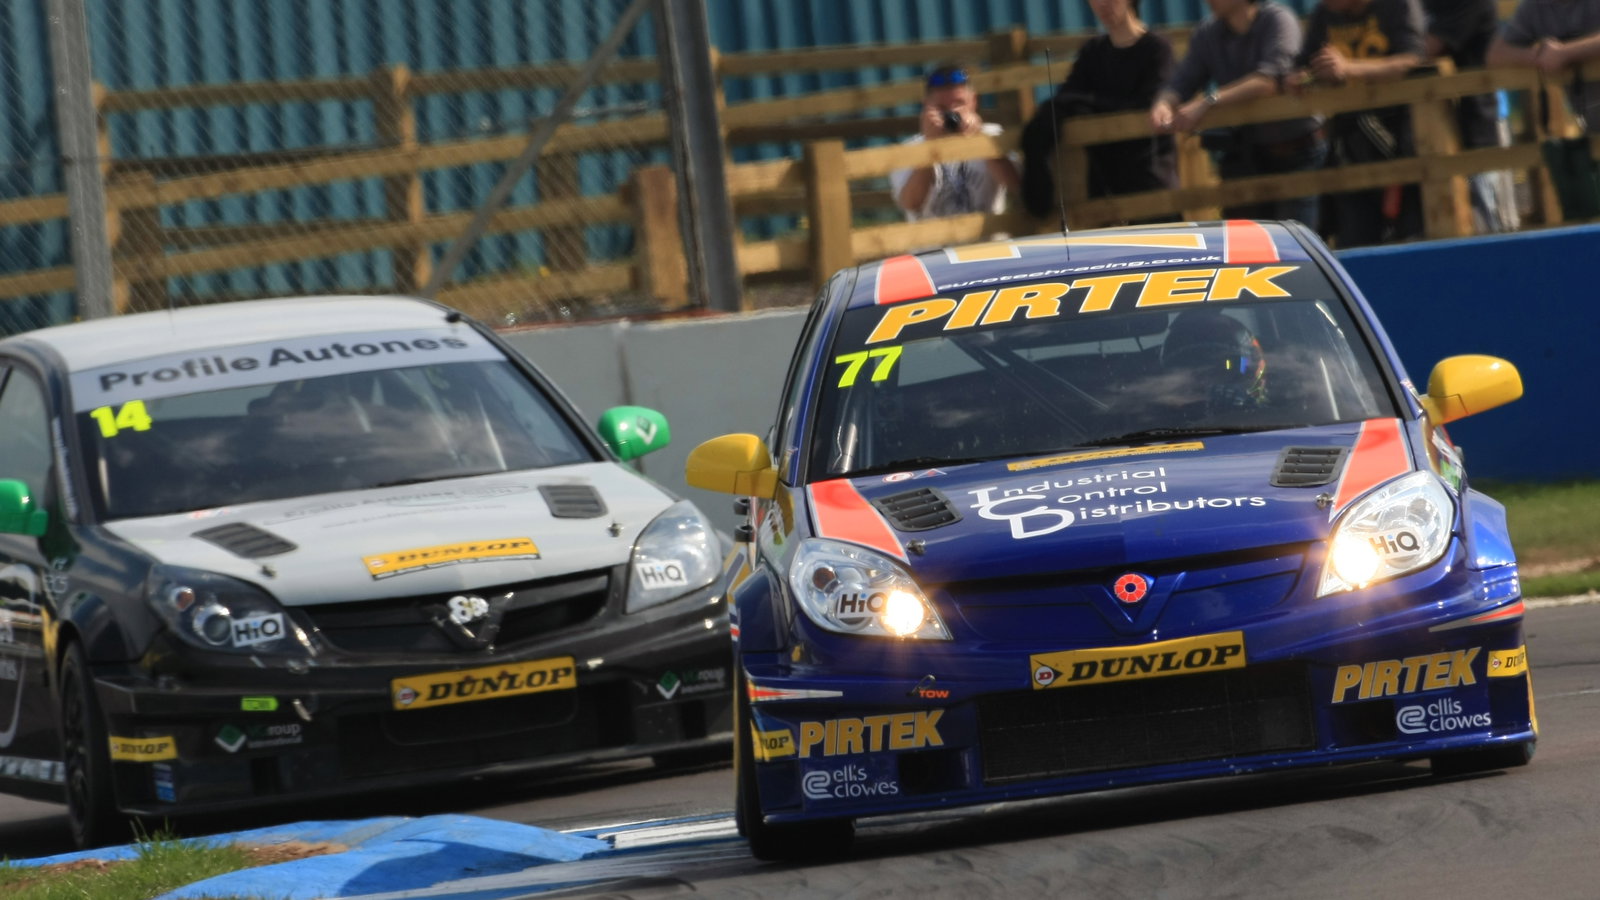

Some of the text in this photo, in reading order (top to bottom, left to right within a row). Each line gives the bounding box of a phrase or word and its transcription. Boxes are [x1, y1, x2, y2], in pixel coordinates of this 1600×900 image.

[938, 255, 1221, 289] eurotechracing.co.uk
[865, 266, 1300, 344] PIRTEK
[99, 337, 468, 392] Profile Autones
[835, 345, 903, 388] 77
[90, 399, 152, 438] 14
[968, 467, 1166, 508] Industrial
[978, 482, 1167, 520] Control
[1009, 494, 1267, 540] Distributors
[1369, 531, 1420, 555] HiQ
[642, 563, 684, 584] HiQ
[235, 618, 280, 643] HiQ
[1068, 644, 1242, 682] DUNLOP
[1331, 647, 1482, 704] PIRTEK
[426, 667, 573, 701] DUNLOP
[919, 690, 950, 699] TOW
[1428, 697, 1462, 717] ellis
[1429, 712, 1491, 732] clowes
[798, 709, 945, 759] PIRTEK
[833, 763, 867, 782] ellis
[834, 781, 899, 799] clowes
